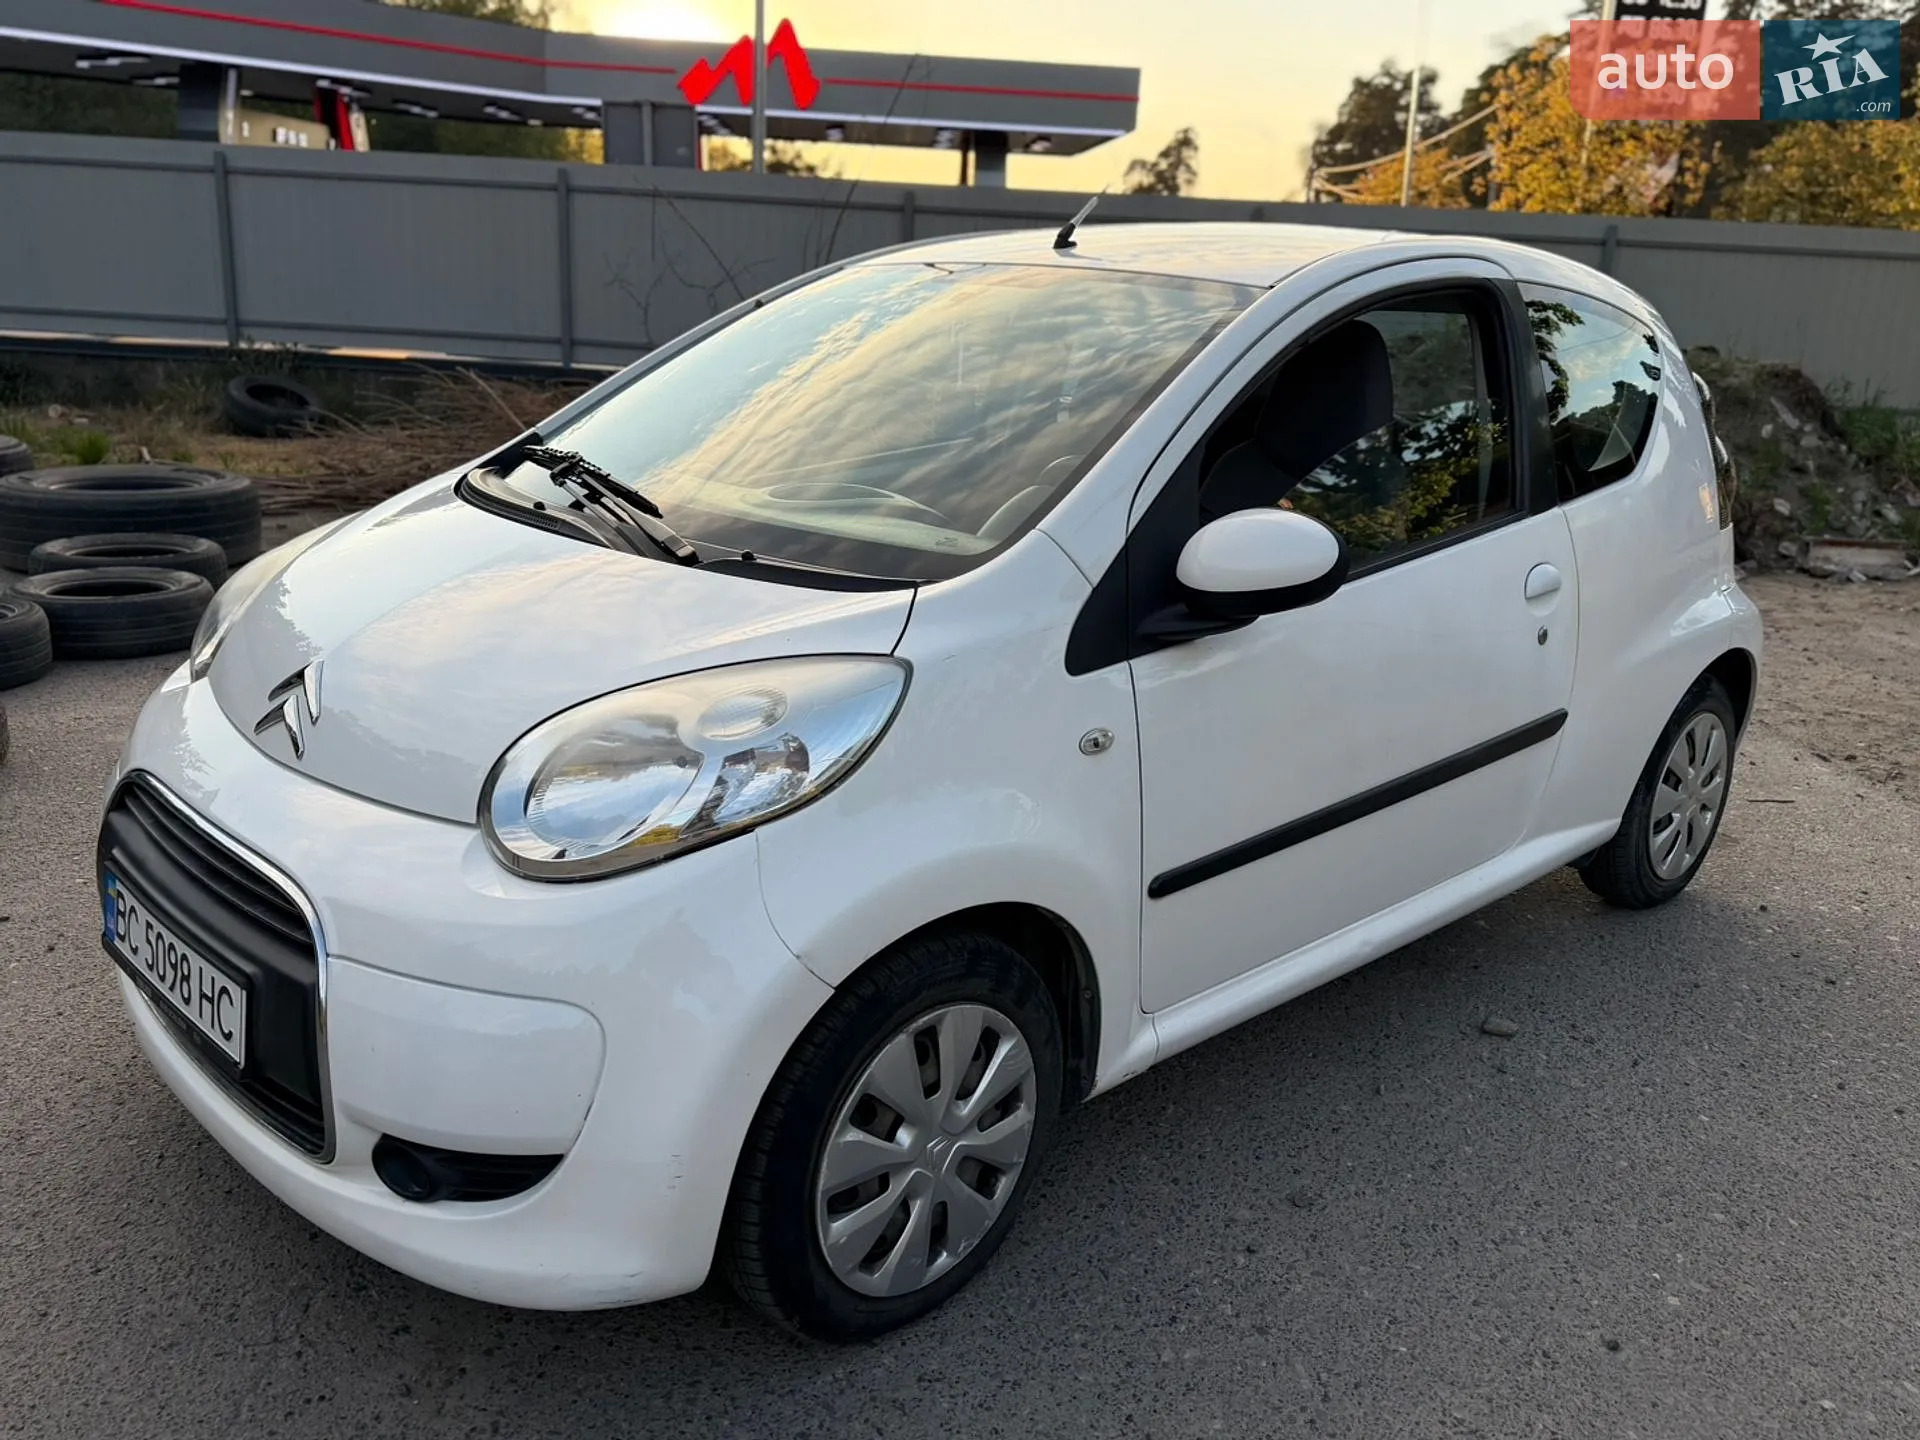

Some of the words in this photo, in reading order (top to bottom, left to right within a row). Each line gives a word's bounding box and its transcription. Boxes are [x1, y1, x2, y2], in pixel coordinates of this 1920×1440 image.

[115, 889, 140, 955] BC
[144, 919, 192, 1007] 5098
[199, 965, 234, 1042] HC
